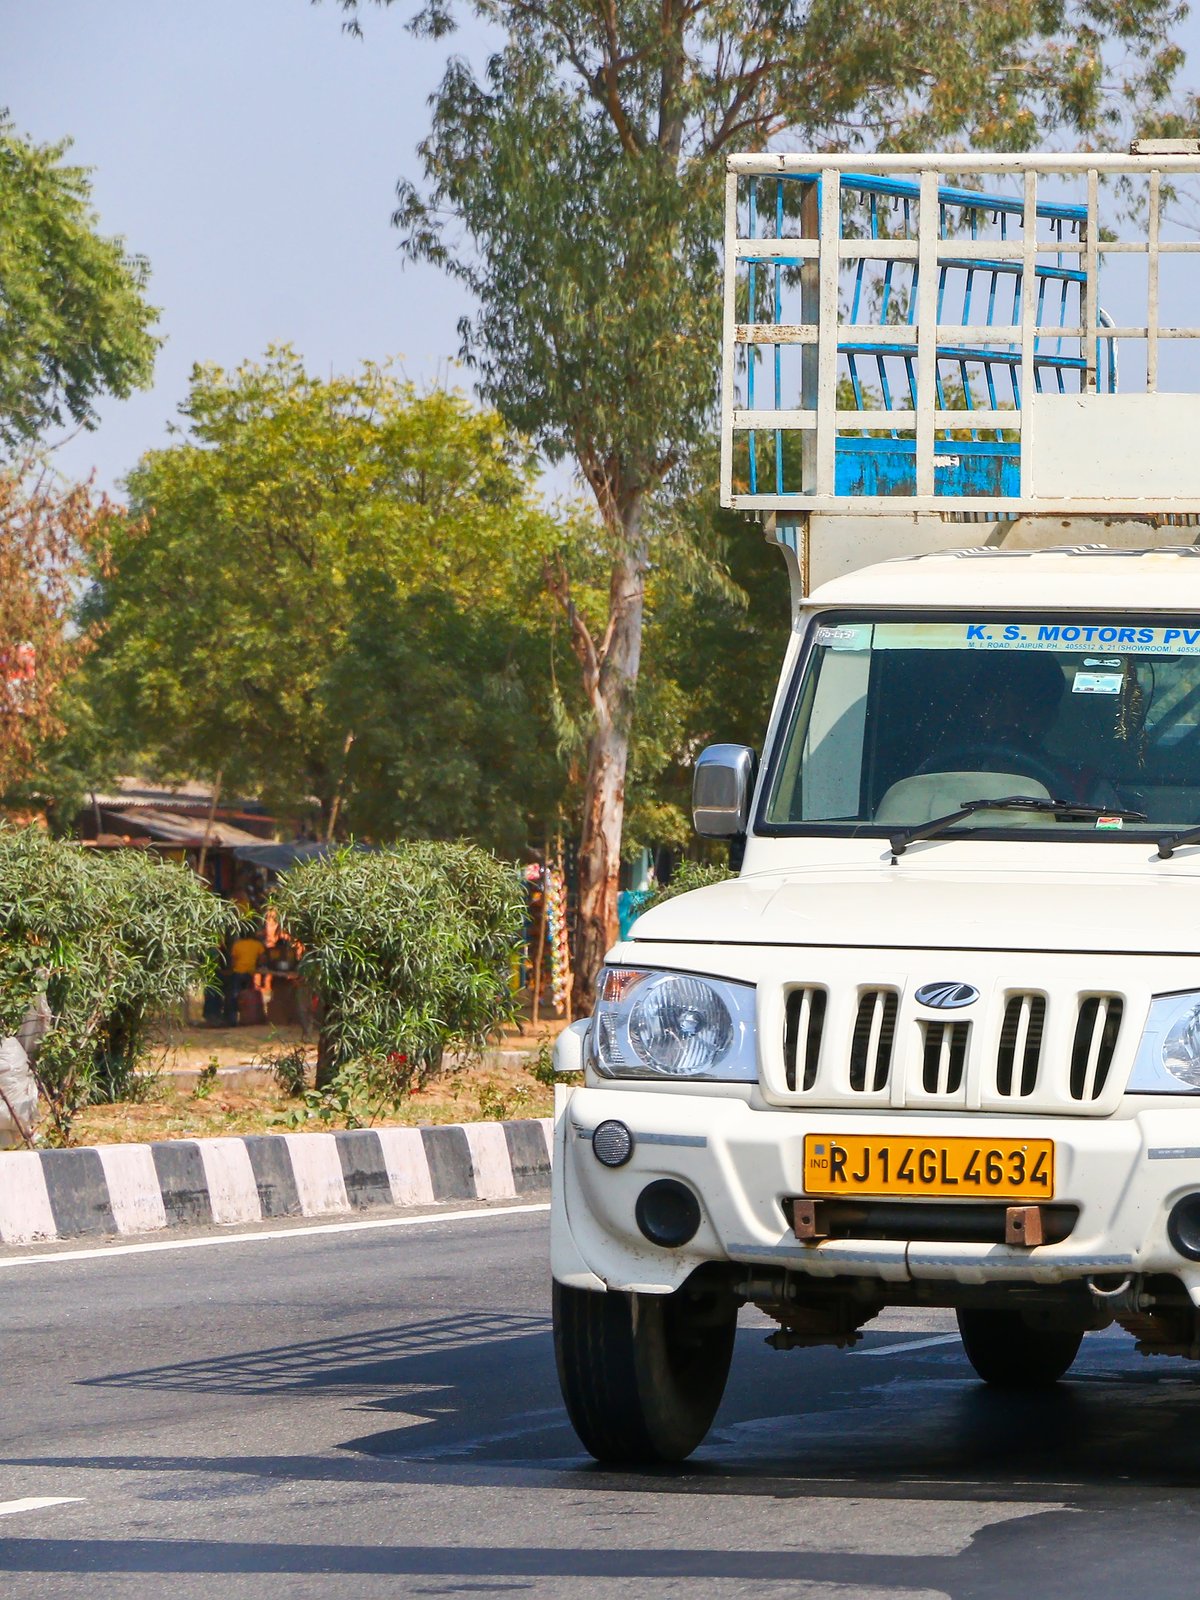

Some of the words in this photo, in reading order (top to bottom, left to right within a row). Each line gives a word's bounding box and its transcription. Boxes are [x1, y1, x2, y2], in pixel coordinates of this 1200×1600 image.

[966, 625, 993, 640] K.
[1003, 626, 1027, 641] S.
[1038, 626, 1154, 643] MOTORS
[810, 1158, 828, 1169] IND
[830, 1146, 1048, 1186] RJ14GL4634
